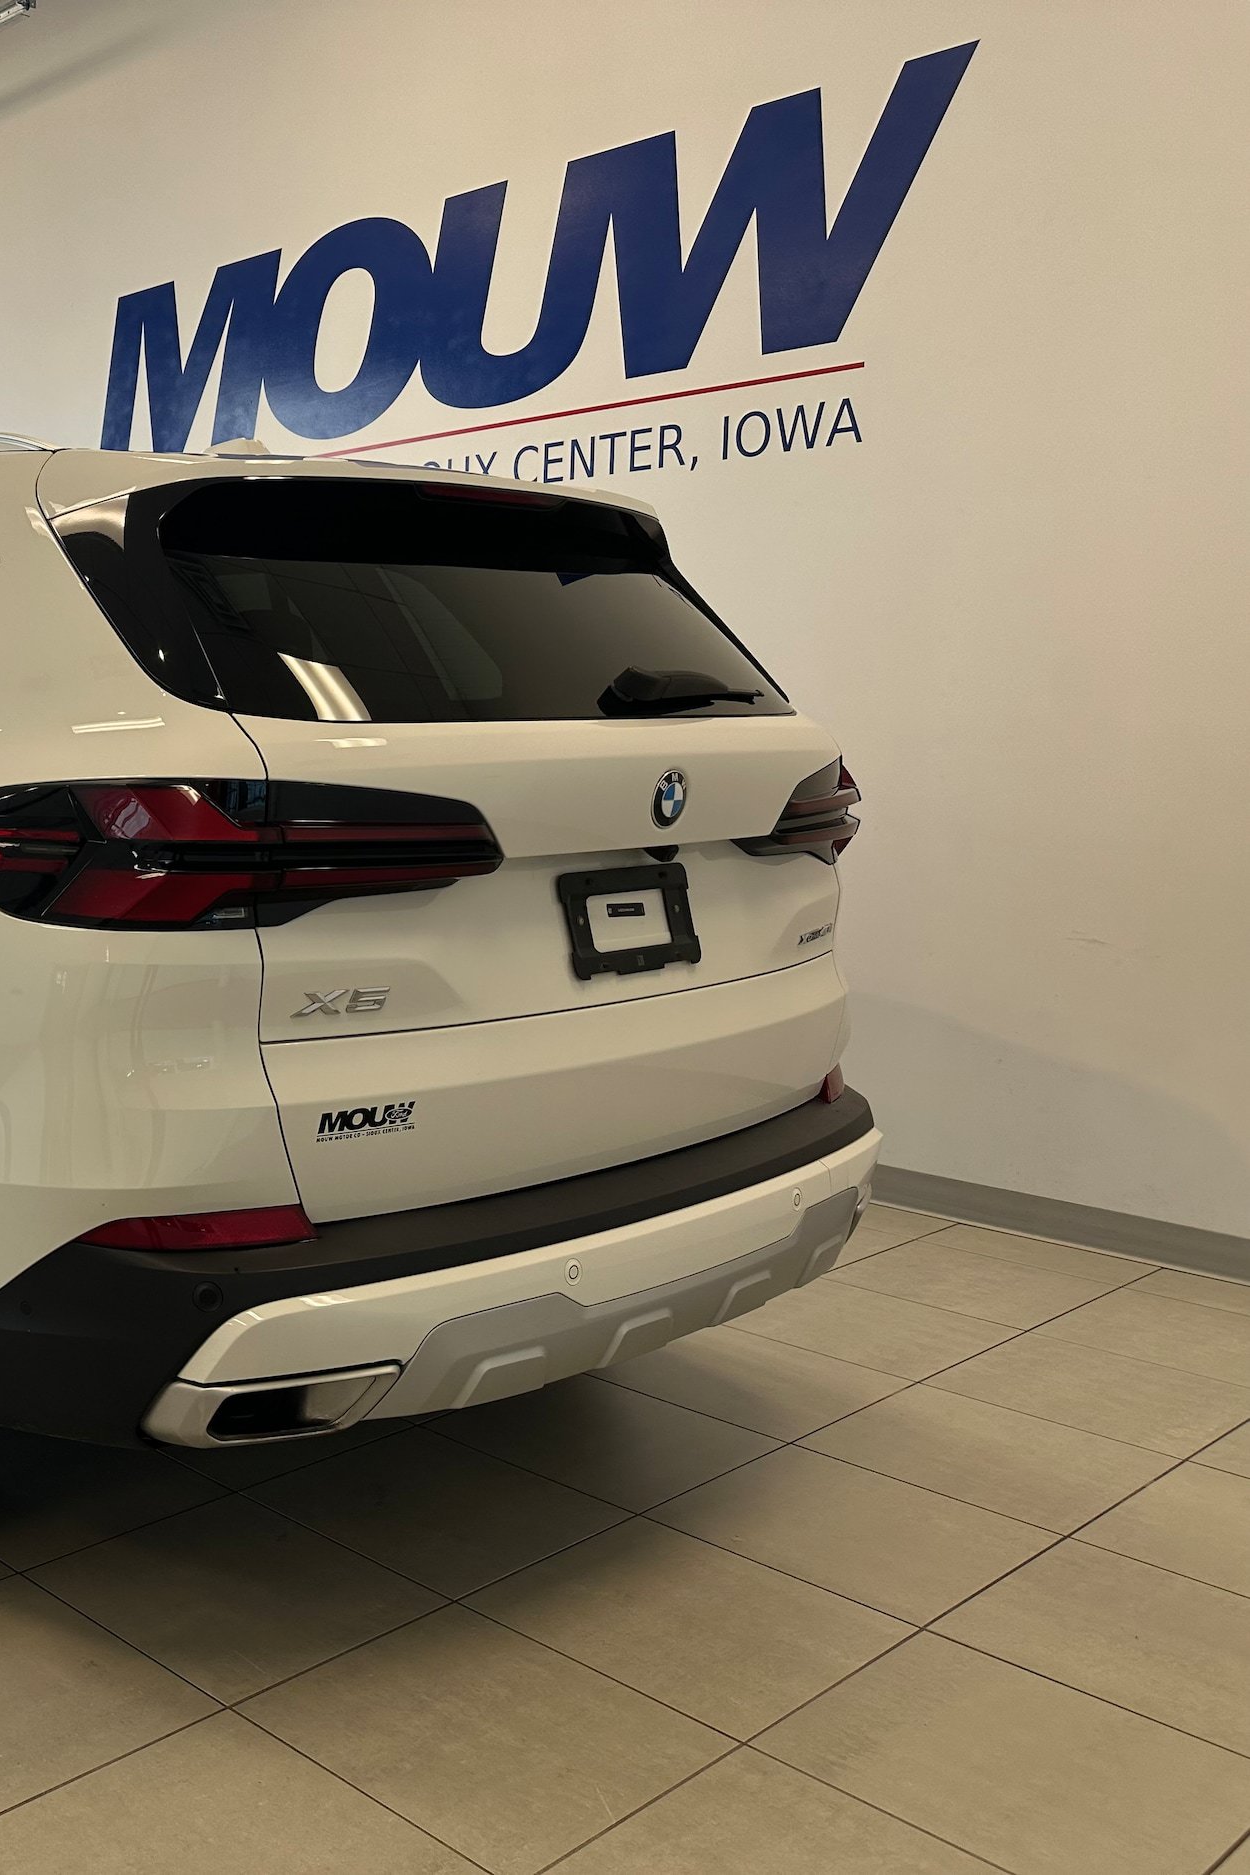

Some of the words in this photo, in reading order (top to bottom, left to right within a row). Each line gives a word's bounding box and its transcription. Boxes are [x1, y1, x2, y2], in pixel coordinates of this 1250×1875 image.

[101, 39, 980, 453] MOUW
[513, 423, 699, 484] CENTER,
[722, 397, 863, 460] IOWA
[659, 772, 687, 791] BMW
[289, 986, 391, 1018] X5
[317, 1101, 416, 1134] MOUW
